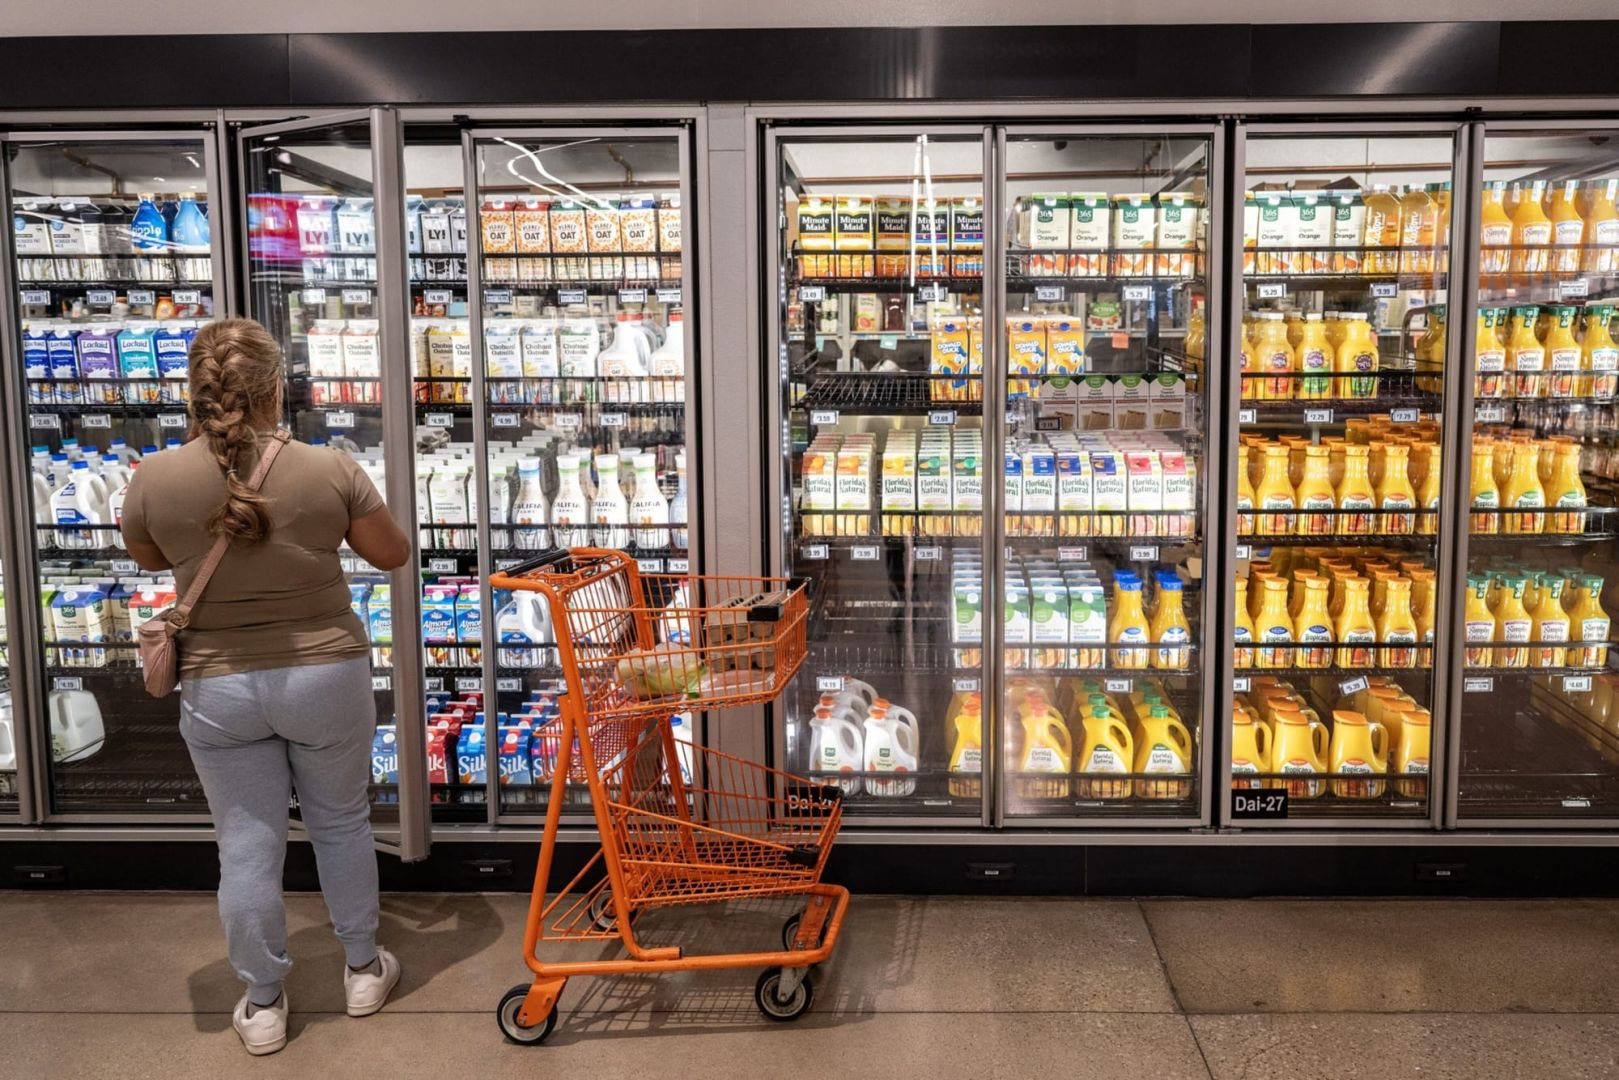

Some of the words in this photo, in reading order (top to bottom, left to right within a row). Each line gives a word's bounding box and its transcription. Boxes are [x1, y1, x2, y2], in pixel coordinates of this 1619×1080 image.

[1301, 208, 1314, 216] 365
[1336, 207, 1349, 215] 365
[306, 231, 329, 244] LY!
[429, 230, 446, 240] LY!
[490, 232, 506, 240] OAT
[524, 232, 540, 240] OAT
[560, 232, 576, 240] OAT
[596, 231, 612, 239] OAT
[629, 230, 644, 238] OAT
[346, 232, 370, 246] LY!
[839, 478, 866, 488] Florida's
[884, 478, 912, 488] Florida's
[920, 478, 948, 488] Florida's
[1025, 480, 1052, 489] Florida's
[1062, 479, 1089, 488] Florida's
[1097, 479, 1124, 488] Florida's
[1132, 479, 1159, 488] Florida's
[839, 485, 866, 494] Natural
[885, 485, 912, 494] Natural
[921, 486, 948, 494] Natural
[1025, 488, 1052, 496] Natural
[1152, 752, 1172, 760] Florida's
[372, 755, 397, 776] Sil
[499, 756, 528, 776] Silk
[1284, 765, 1312, 774] Tropicana
[1342, 766, 1370, 774] Tropicana
[1235, 796, 1284, 812] Dai-27
